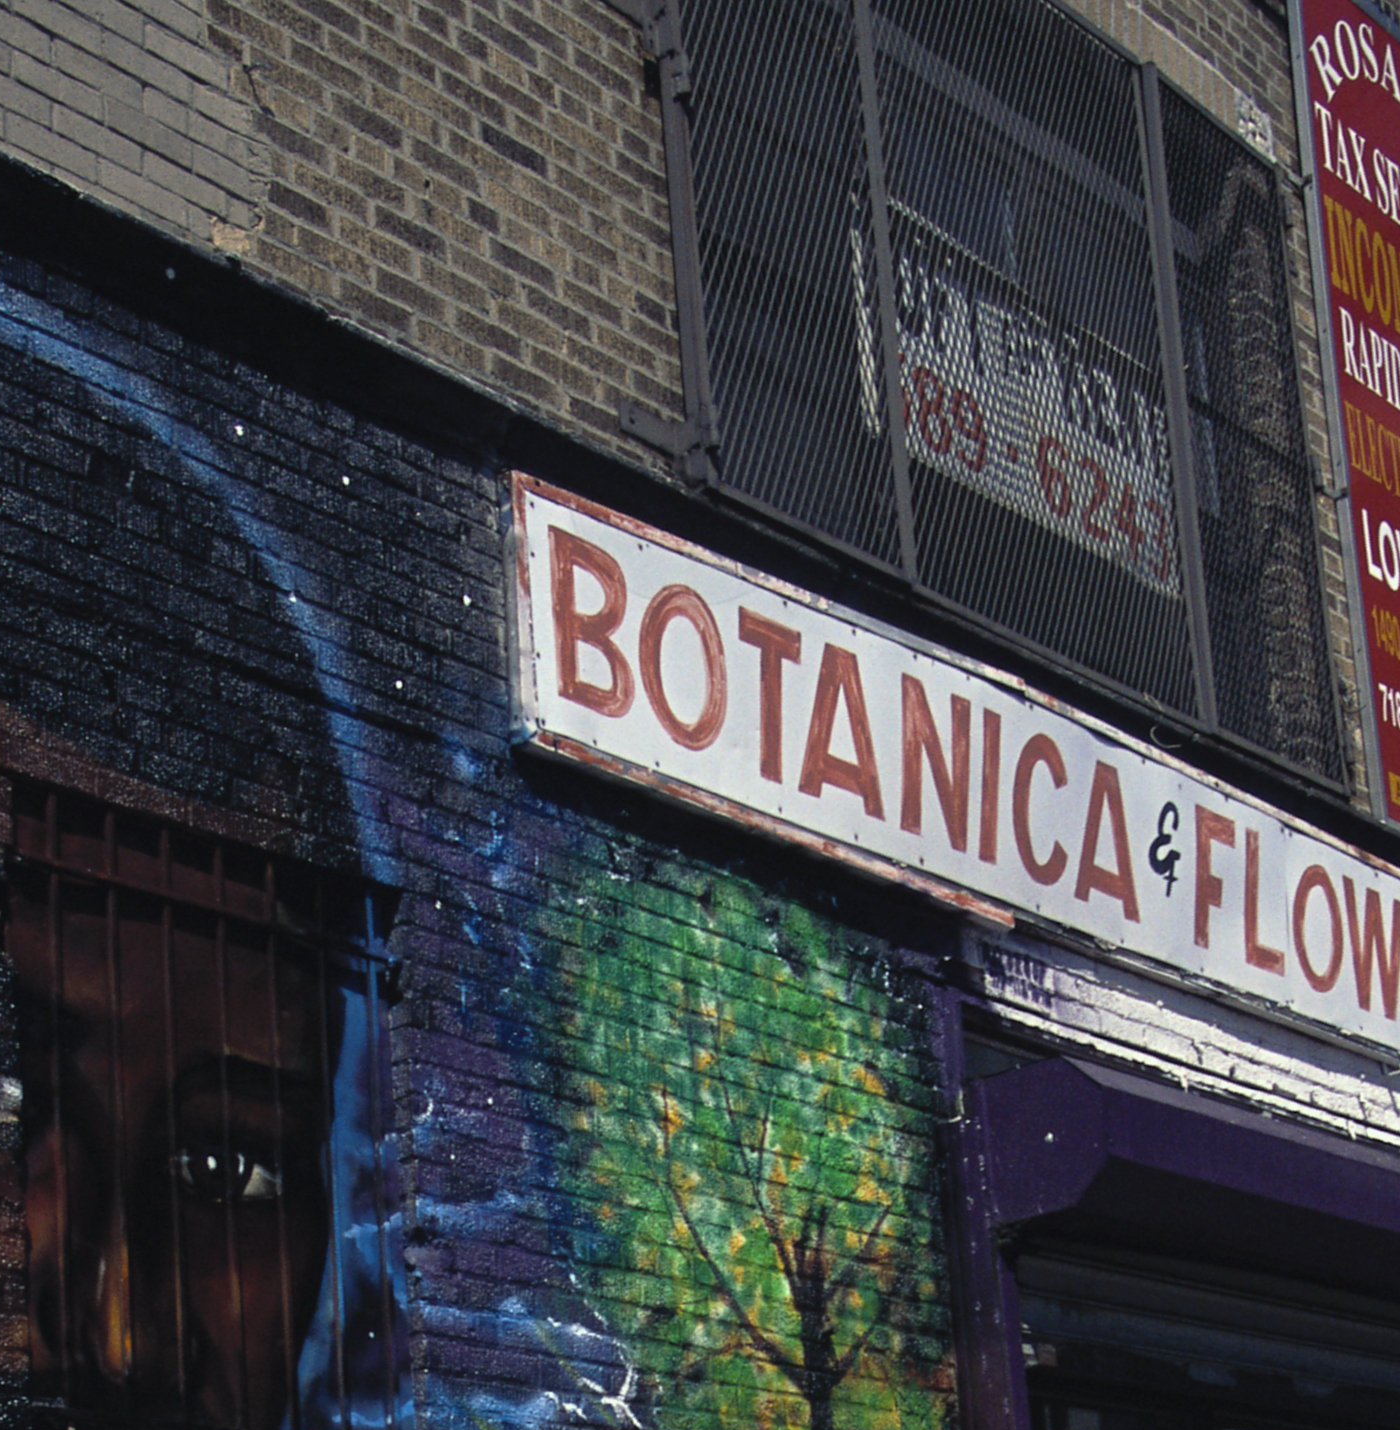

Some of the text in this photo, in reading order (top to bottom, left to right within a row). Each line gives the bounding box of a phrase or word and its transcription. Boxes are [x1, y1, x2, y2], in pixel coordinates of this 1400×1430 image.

[1314, 101, 1373, 203] TAX
[547, 523, 1141, 925] BOTANICA
[1148, 800, 1182, 898] &
